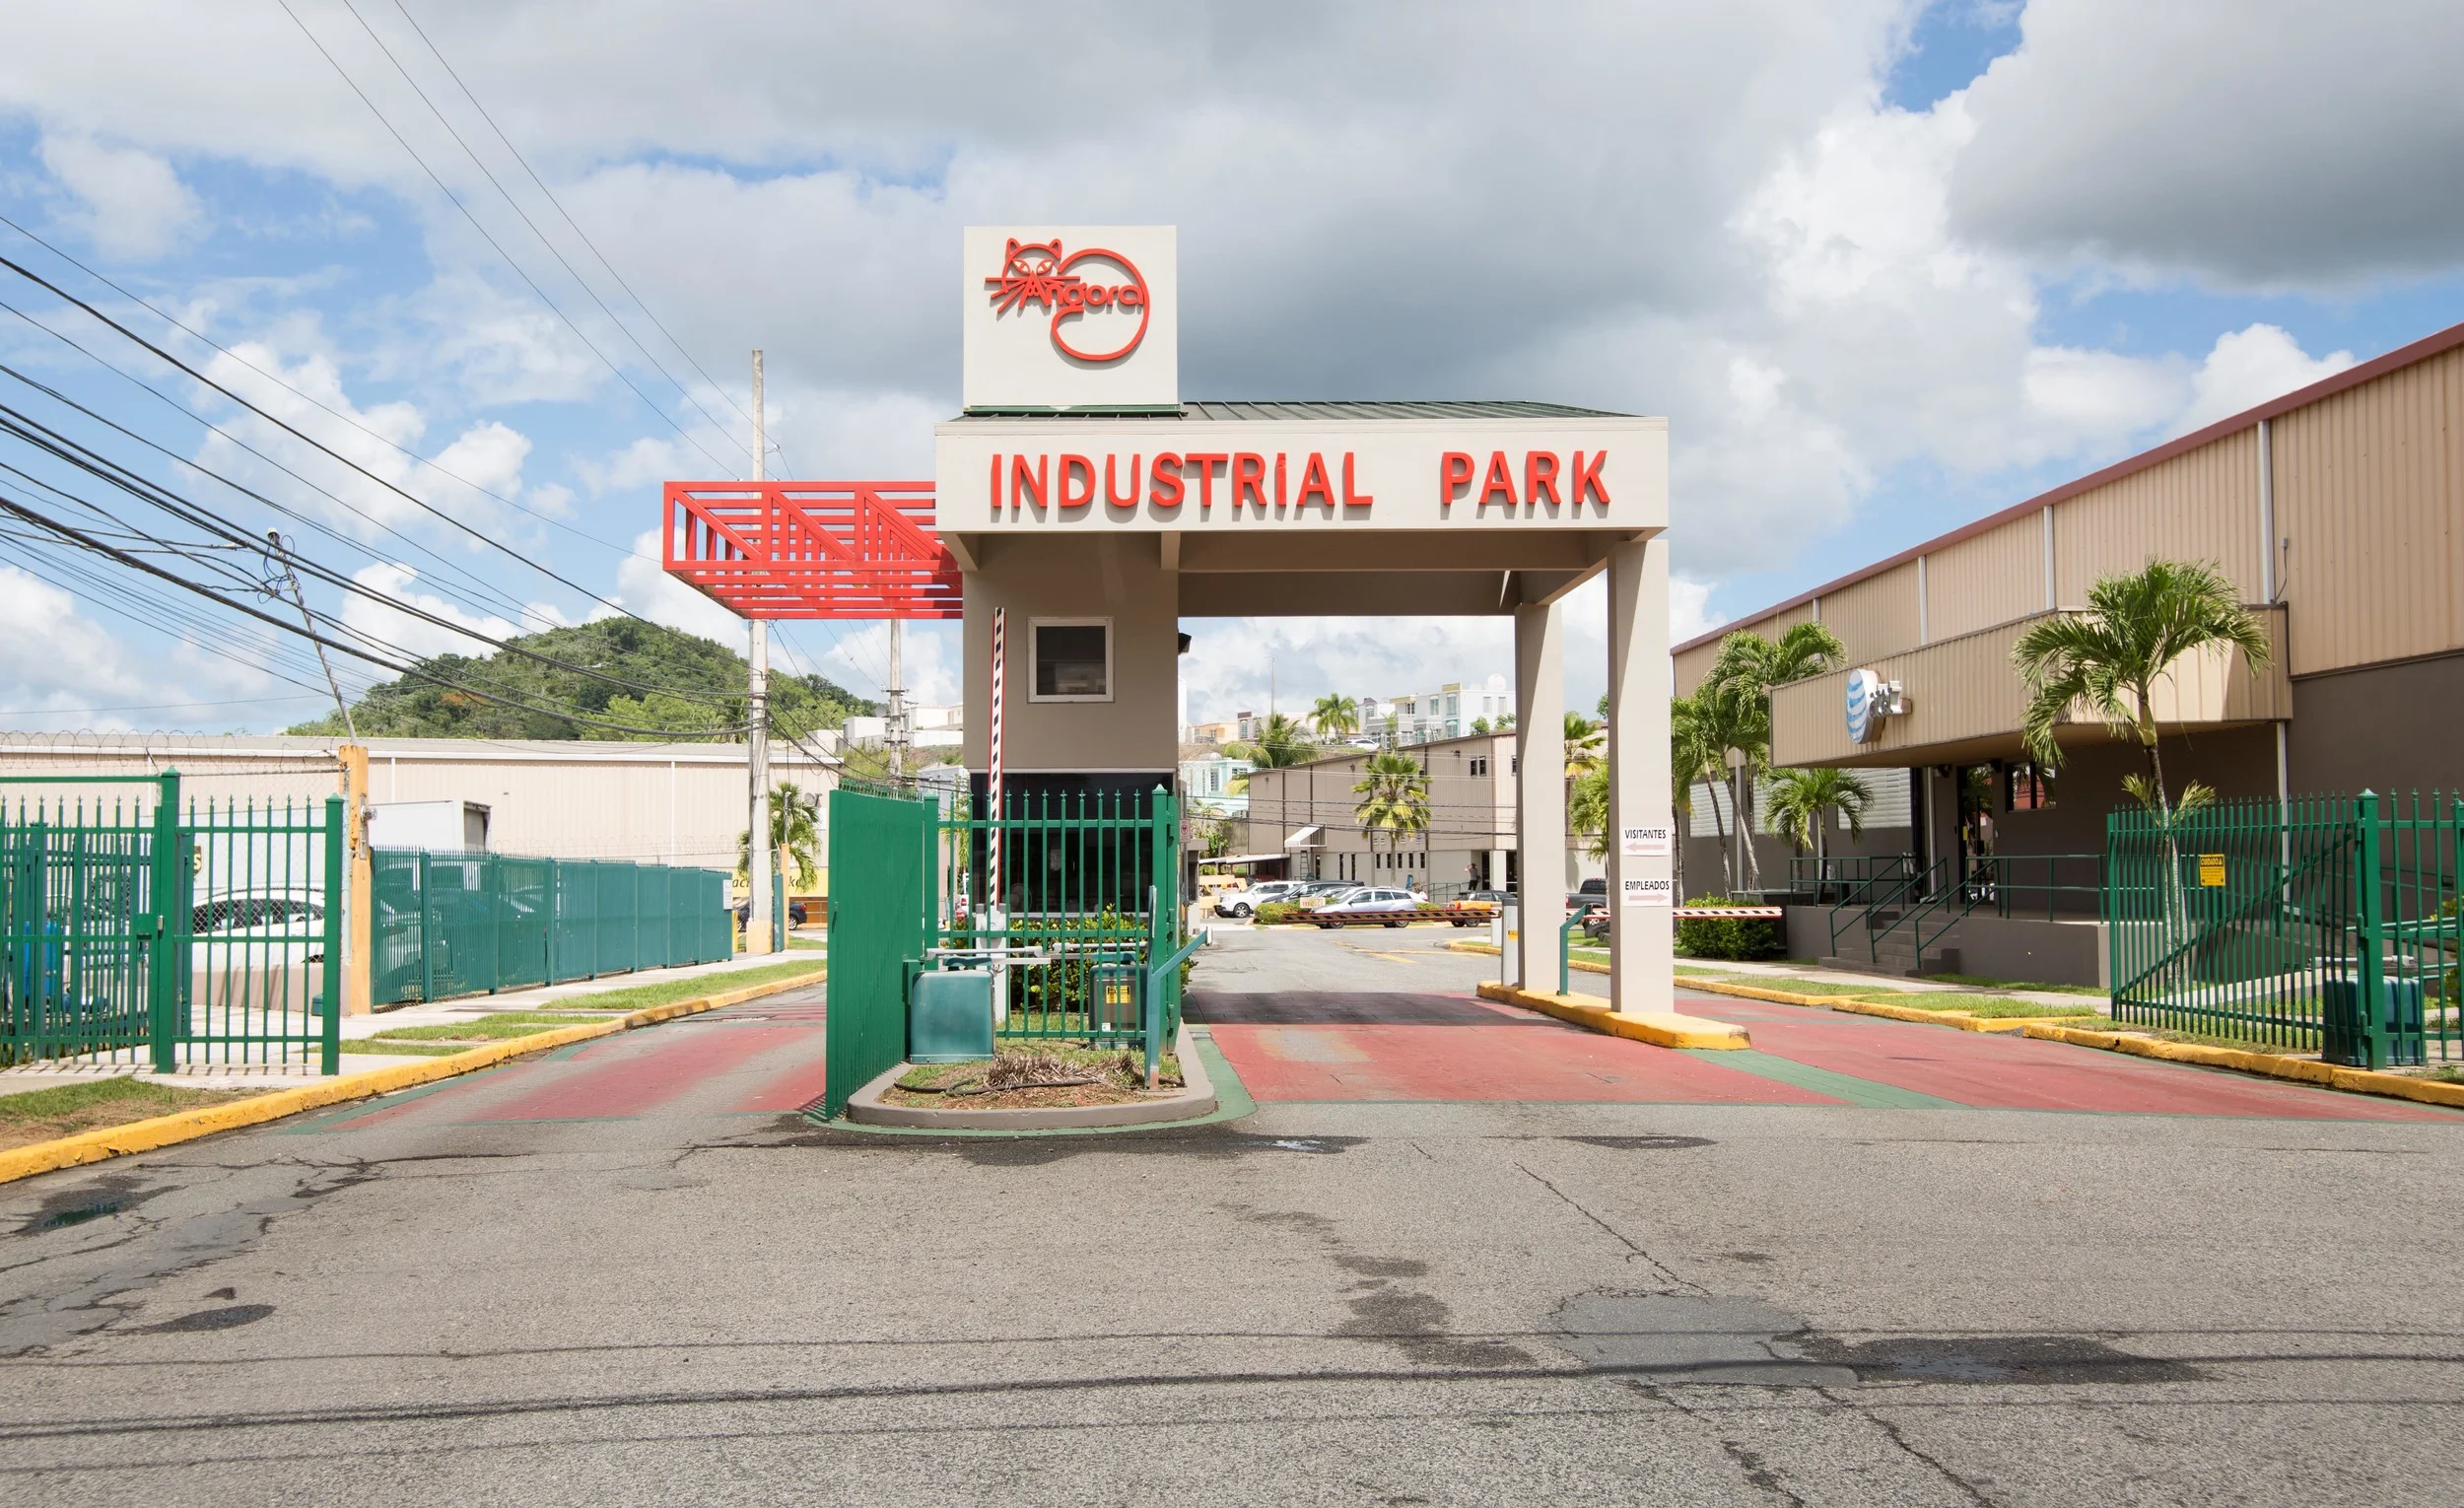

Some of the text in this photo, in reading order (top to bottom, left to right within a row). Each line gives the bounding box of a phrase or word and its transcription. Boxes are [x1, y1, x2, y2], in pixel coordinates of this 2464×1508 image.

[1018, 274, 1144, 310] Angora
[992, 449, 1611, 508] INDUSTRIAL PARK
[1624, 829, 1667, 839] VISITANTES
[1624, 880, 1670, 890] EMPLEADOS
